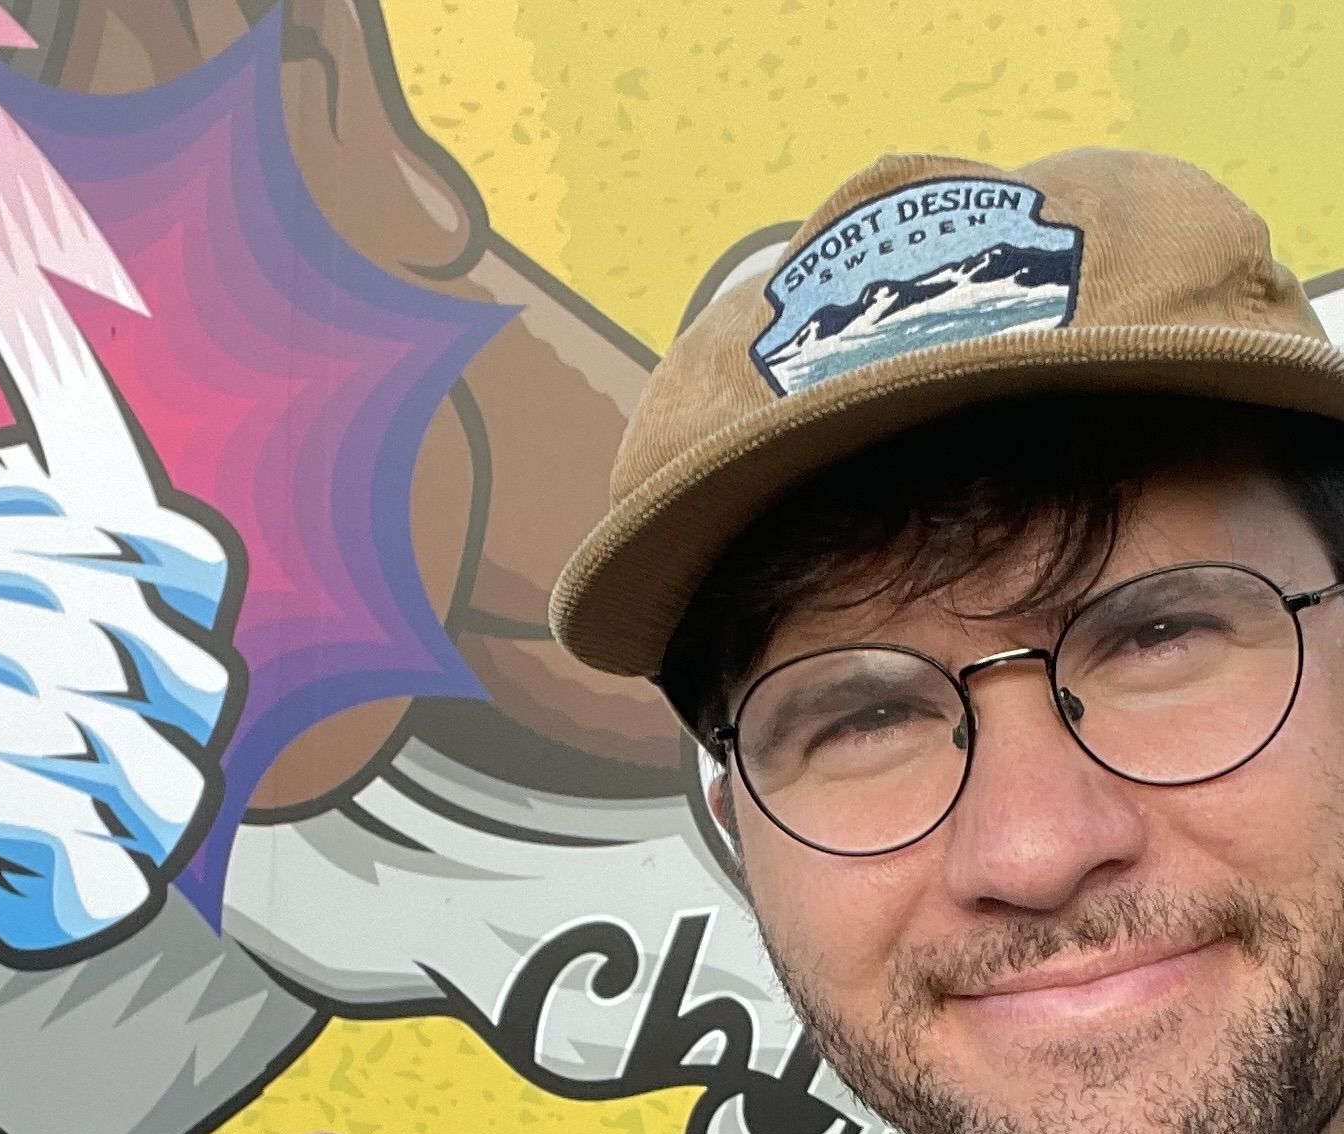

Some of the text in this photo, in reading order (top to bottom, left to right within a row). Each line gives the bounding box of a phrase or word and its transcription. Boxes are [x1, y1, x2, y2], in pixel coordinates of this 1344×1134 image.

[783, 187, 1022, 293] SPORT DESIGN
[818, 212, 987, 285] SWEDEN
